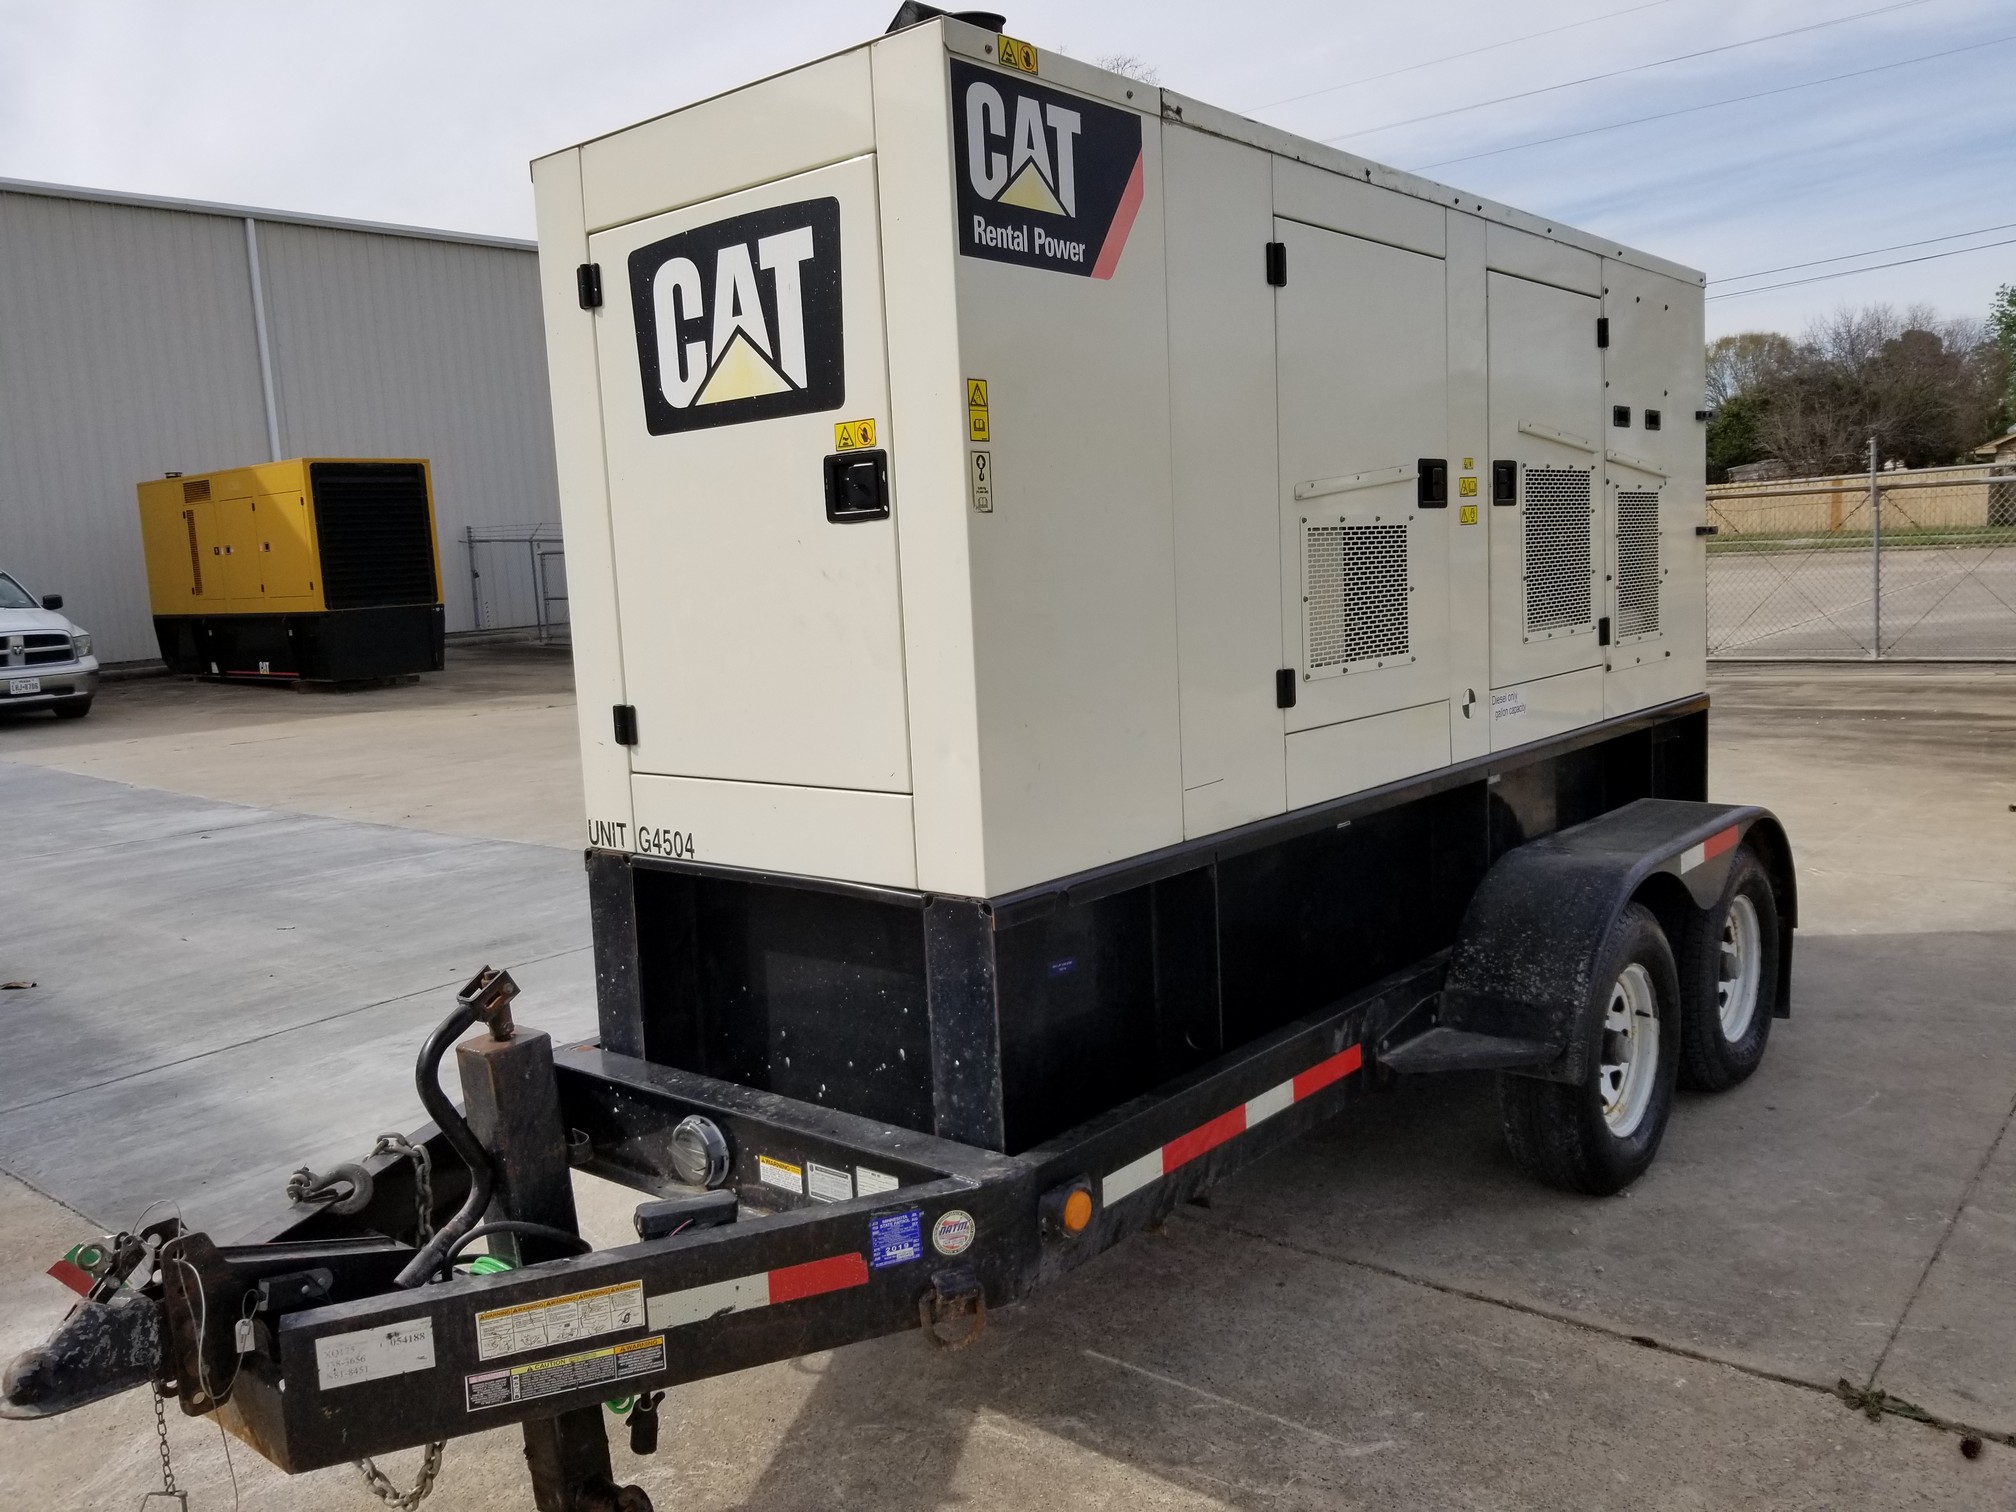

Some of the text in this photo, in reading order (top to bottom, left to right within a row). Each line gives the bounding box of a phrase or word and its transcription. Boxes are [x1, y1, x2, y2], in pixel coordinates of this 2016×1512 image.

[966, 81, 1081, 218] CAT
[973, 214, 1086, 263] Rental Power
[652, 225, 814, 409] CAT
[259, 661, 270, 675] CAT
[1492, 692, 1517, 705] Diesel only
[587, 819, 696, 859] UNIT G4504
[886, 1243, 909, 1253] 2019
[390, 1332, 425, 1347] 054188
[626, 1339, 659, 1352] WARNING
[534, 1359, 566, 1370] CAUTION
